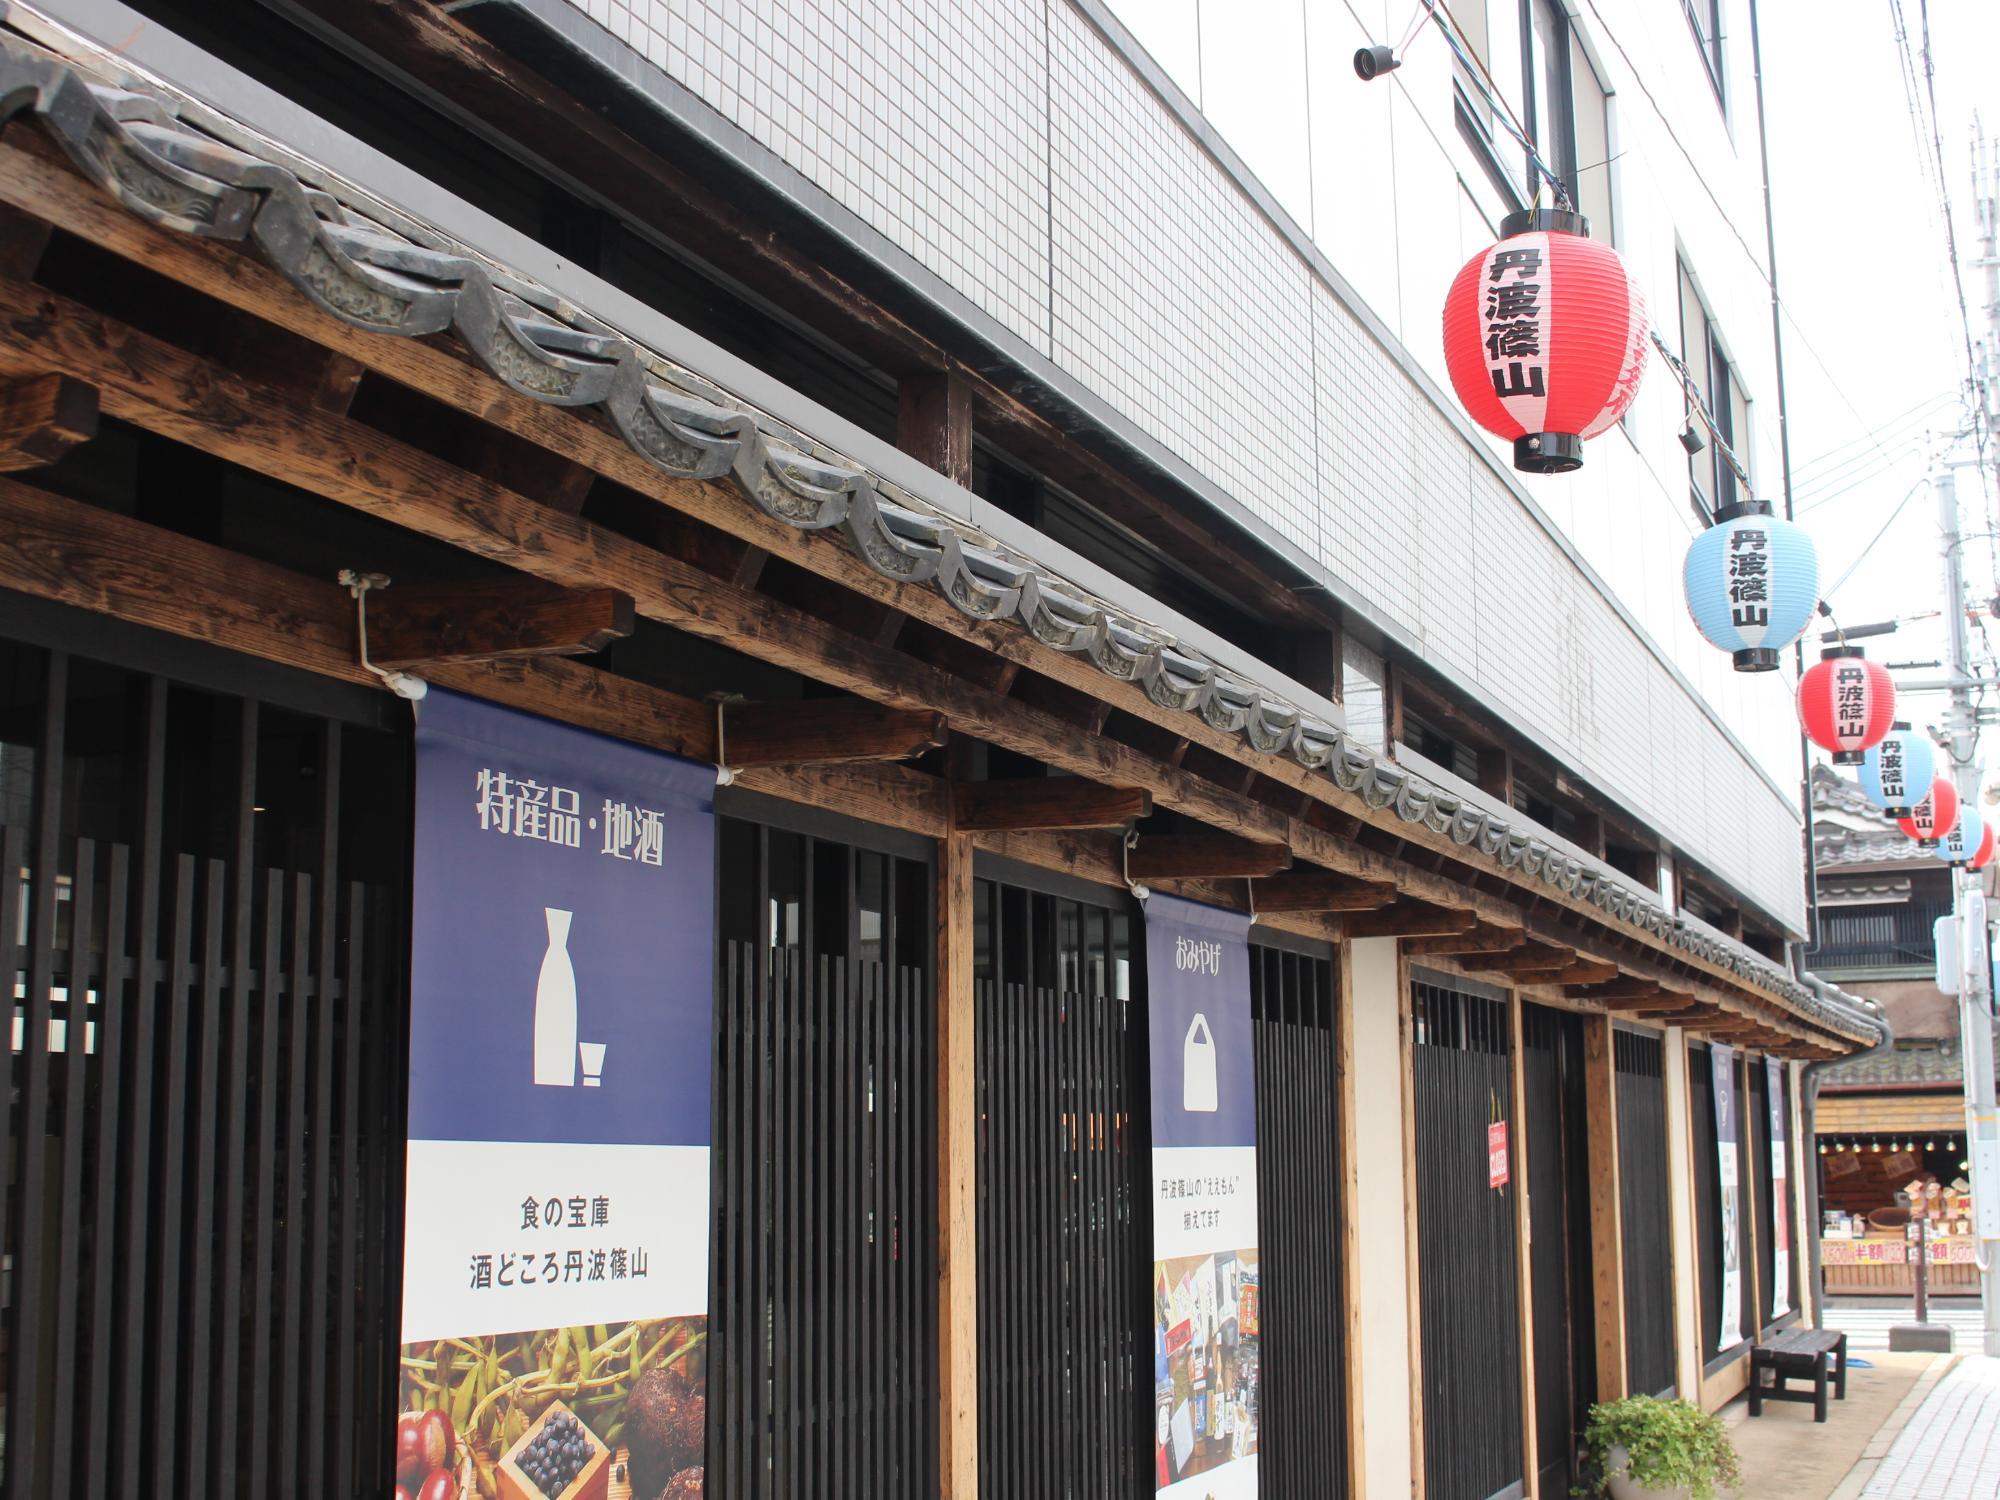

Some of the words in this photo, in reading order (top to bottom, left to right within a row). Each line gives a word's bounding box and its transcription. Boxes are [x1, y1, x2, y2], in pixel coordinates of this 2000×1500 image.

[1486, 248, 1546, 398] 丹波篠山
[1729, 529, 1768, 627] 丹波篠山
[1837, 667, 1864, 737] 丹波篠山
[1880, 740, 1904, 797] 丹波篠山
[476, 767, 665, 867] 特産品・地酒
[1176, 936, 1222, 977] おみやげ
[521, 1194, 610, 1231] 食の宝庫
[1184, 1209, 1221, 1231] 揃えてます
[469, 1246, 649, 1290] 酒どころ丹波篠山
